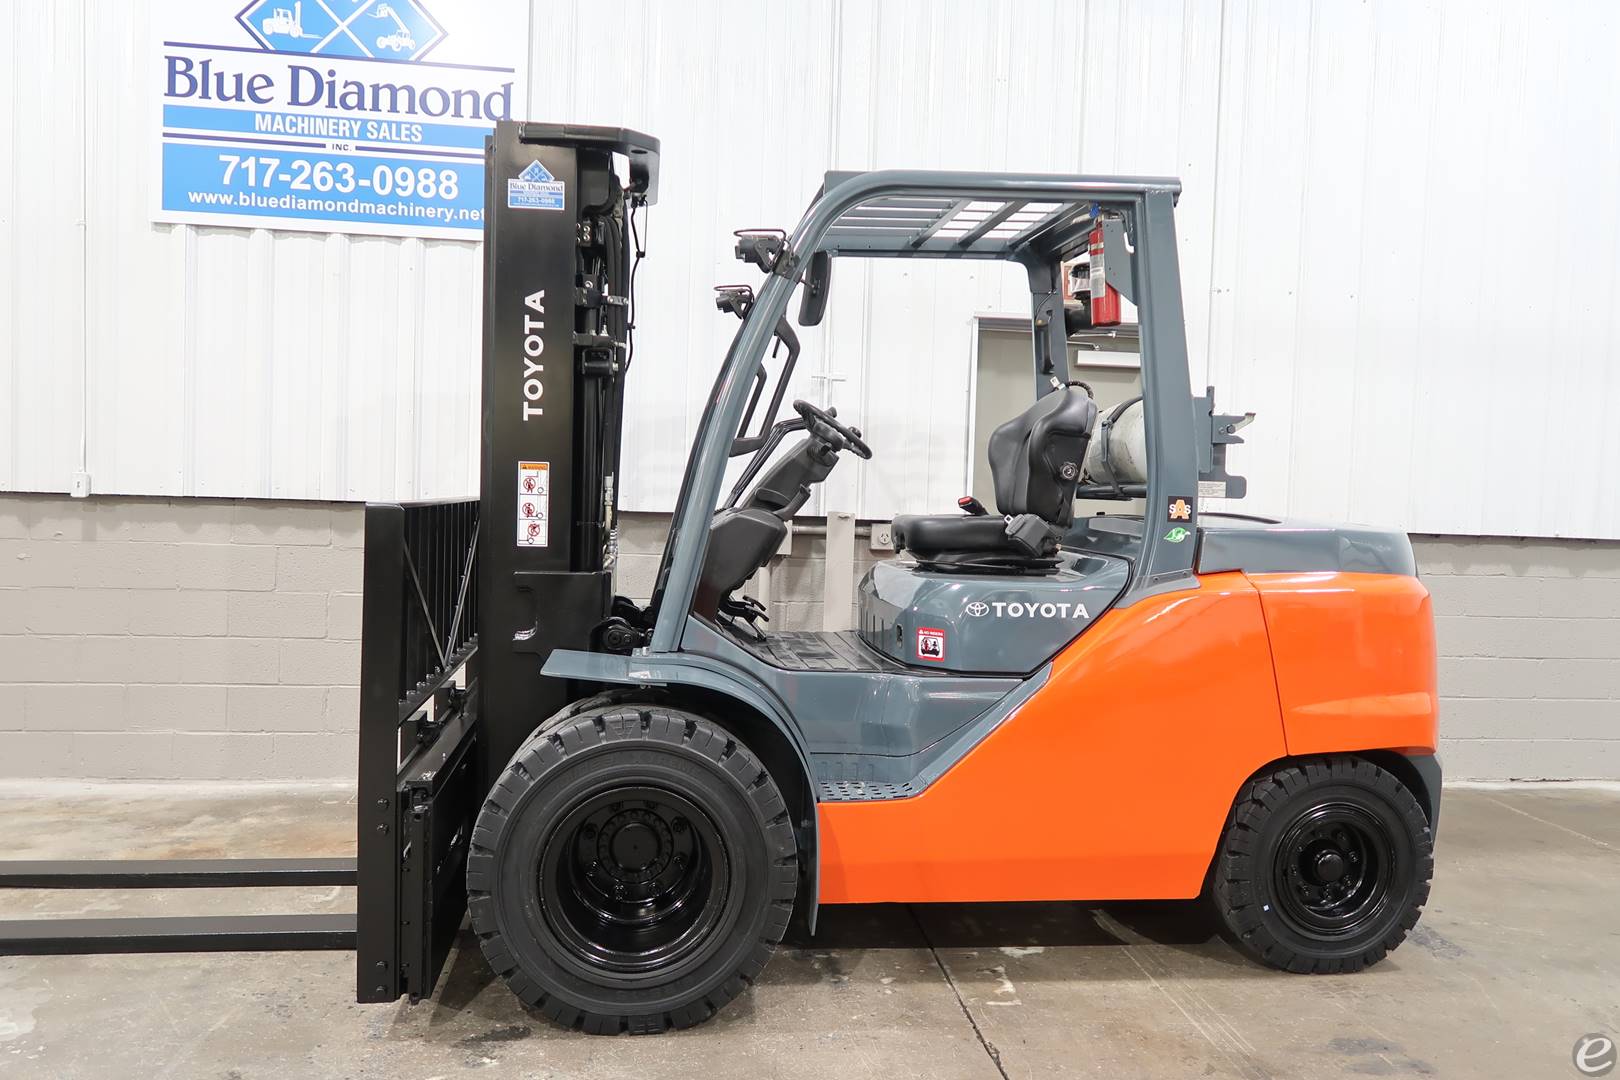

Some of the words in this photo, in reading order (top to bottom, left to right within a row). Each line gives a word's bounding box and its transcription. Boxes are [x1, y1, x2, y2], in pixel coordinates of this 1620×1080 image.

[164, 55, 275, 104] Blue
[287, 65, 514, 121] Diamond
[255, 113, 362, 138] MACHINERY
[366, 121, 423, 142] SALES
[332, 143, 352, 152] INC.
[218, 154, 459, 200] 717-263-0988
[523, 290, 545, 421] TOYOTA
[992, 602, 1090, 619] TOYOTA
